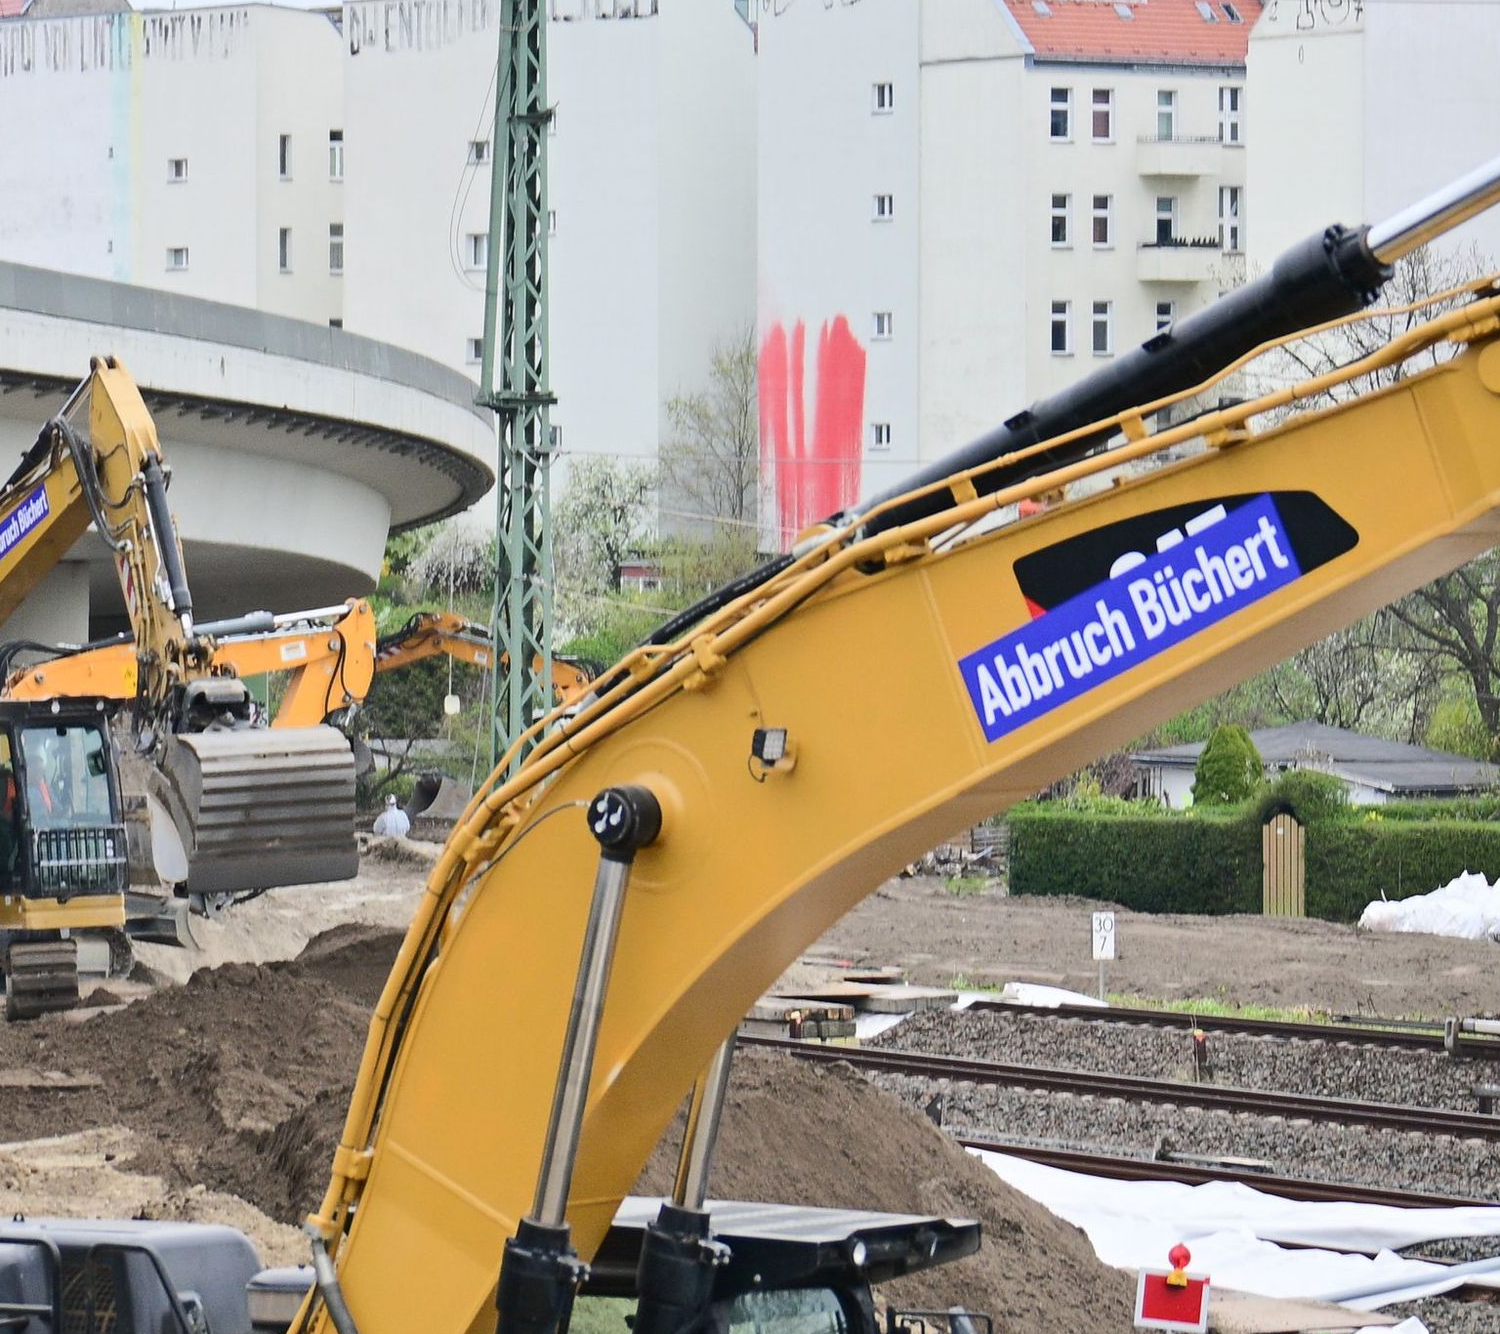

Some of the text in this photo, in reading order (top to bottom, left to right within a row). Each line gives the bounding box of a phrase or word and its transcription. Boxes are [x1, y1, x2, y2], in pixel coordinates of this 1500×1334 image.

[17, 489, 48, 534] Büchert
[976, 599, 1136, 726] Abbruch
[1128, 515, 1289, 640] Büchert
[1095, 917, 1114, 933] 30
